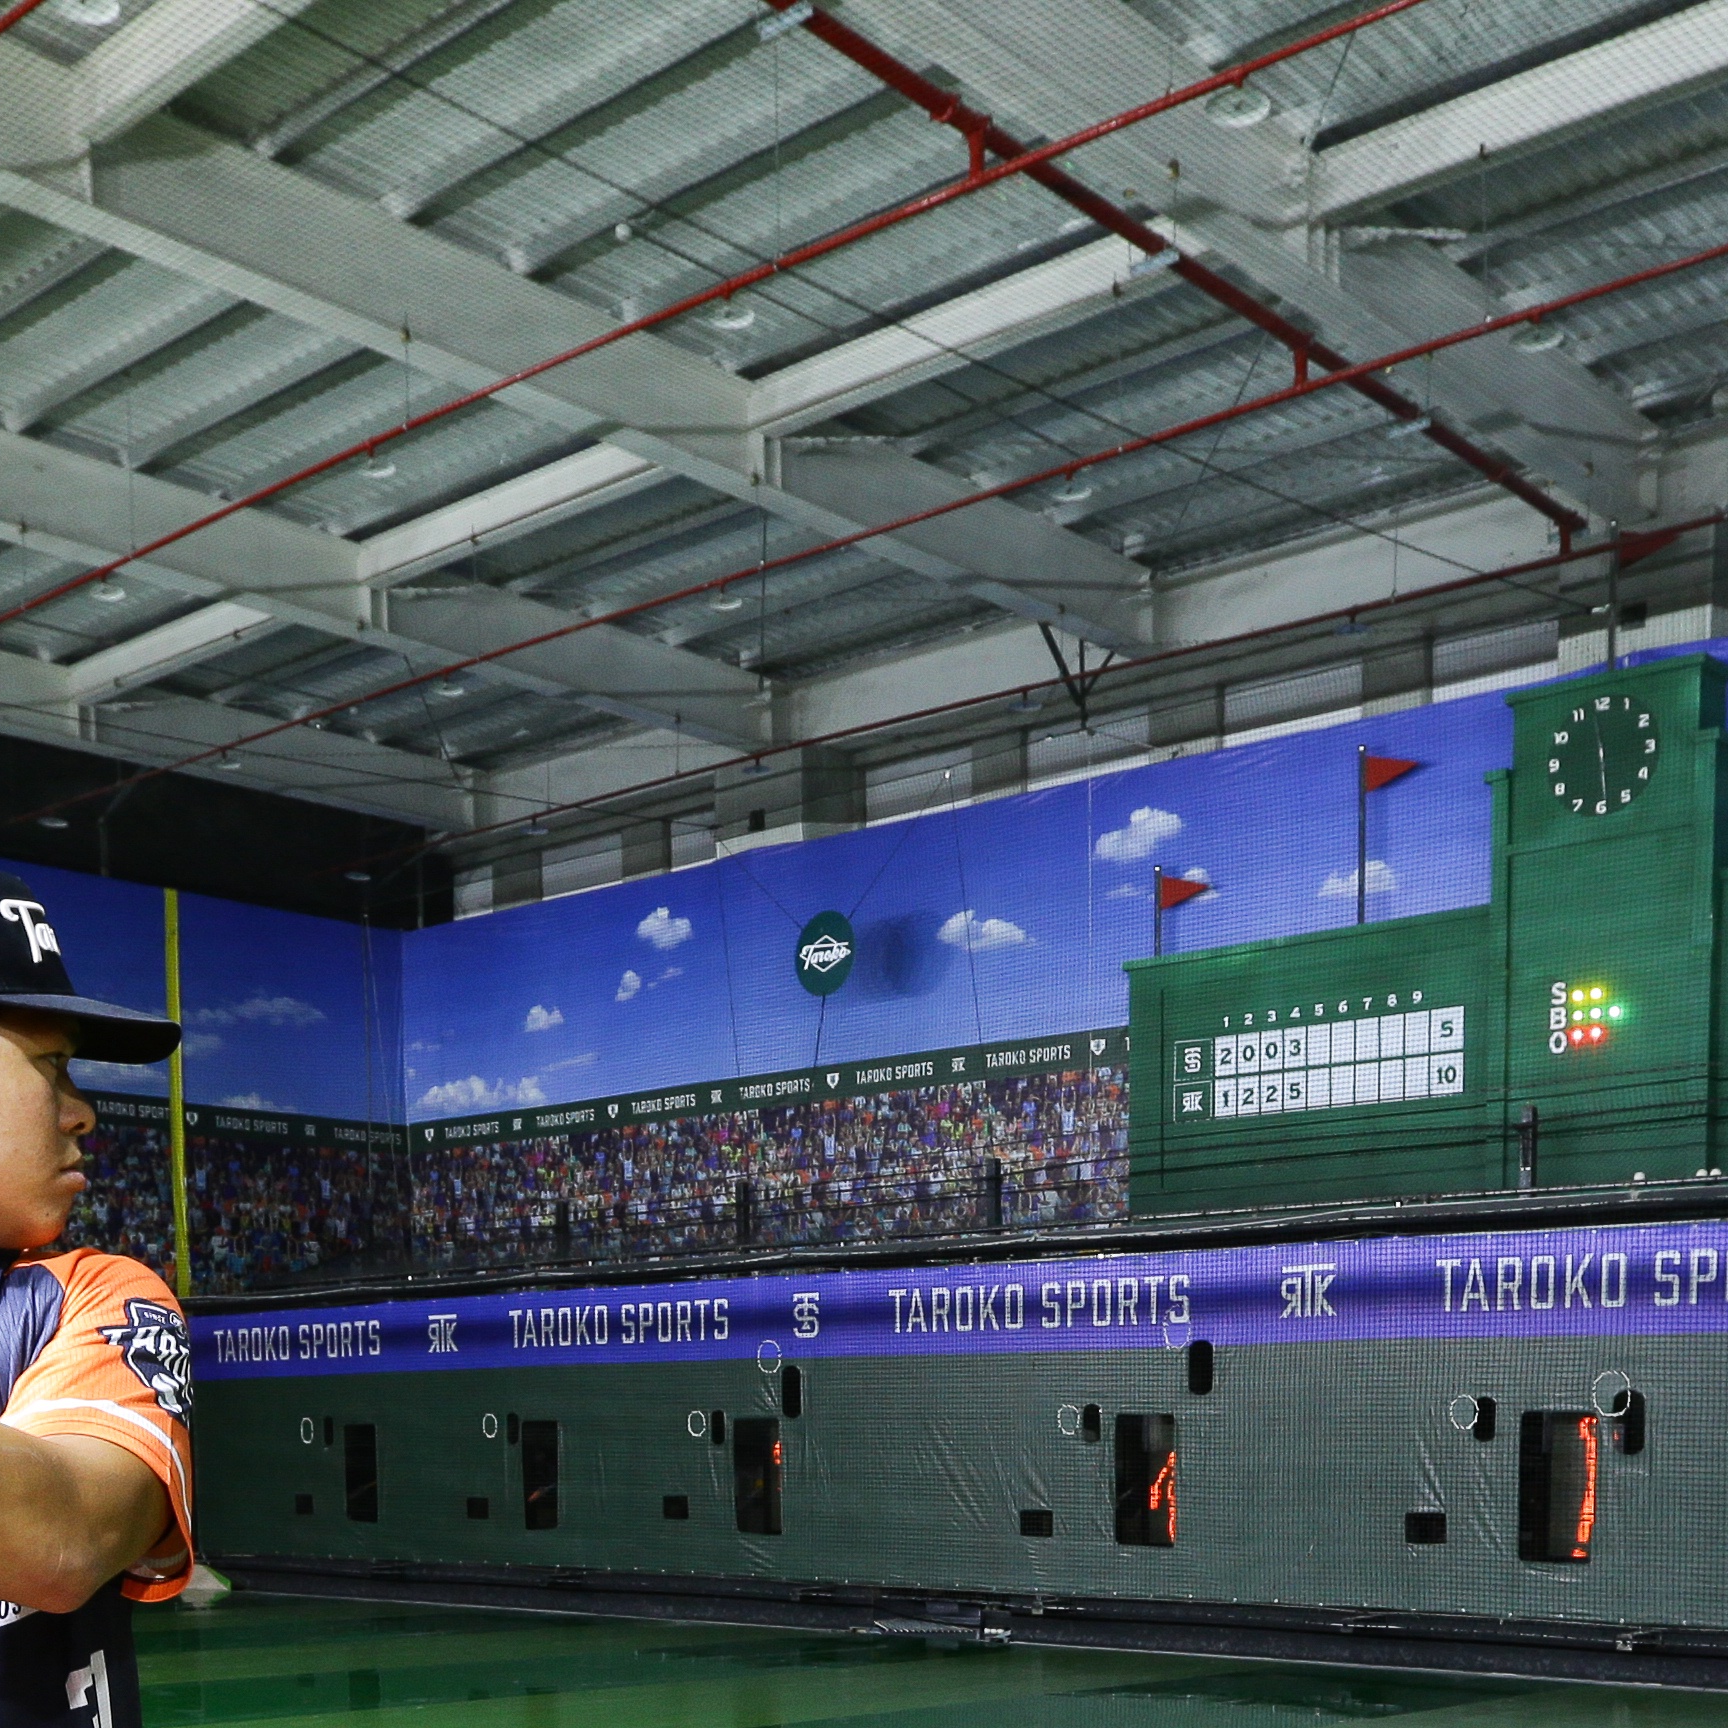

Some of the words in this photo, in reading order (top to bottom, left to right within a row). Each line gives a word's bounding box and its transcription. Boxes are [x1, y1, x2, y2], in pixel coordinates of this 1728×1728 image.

[1594, 696, 1611, 711] 12
[1623, 697, 1630, 711] 1
[1572, 708, 1585, 722] 11
[1638, 713, 1650, 728] 2
[1553, 731, 1569, 745] 10
[1644, 738, 1656, 754] 3
[1548, 758, 1560, 773] 9
[1638, 766, 1649, 780] 4
[1554, 782, 1566, 796] 8
[1620, 789, 1631, 804] 5
[1572, 798, 1584, 812] 7
[1595, 799, 1607, 815] 6
[801, 941, 850, 971] Taroko
[1551, 981, 1567, 1005] S
[1222, 1016, 1230, 1028] 1
[1244, 1013, 1254, 1026] 2
[1267, 1010, 1277, 1023] 3
[1289, 1006, 1301, 1019] 4
[1314, 1003, 1324, 1017] 5
[1338, 1000, 1349, 1014] 6
[1362, 996, 1373, 1010] 7
[1387, 993, 1398, 1007] 8
[1412, 990, 1423, 1004] 9
[1550, 1006, 1568, 1030] B
[1220, 1048, 1232, 1066] 2
[1242, 1044, 1255, 1062] 0
[1265, 1041, 1278, 1059] 0
[1289, 1038, 1302, 1056] 3
[1440, 1020, 1454, 1038] 5
[985, 1050, 1026, 1068] TAROKO
[1029, 1045, 1071, 1064] SPORTS
[856, 1066, 893, 1084] TAROKO
[895, 1061, 934, 1081] SPORTS
[739, 1083, 772, 1099] TAROKO
[775, 1078, 811, 1096] SPORTS
[1222, 1091, 1230, 1108] 1
[1242, 1088, 1255, 1106] 2
[1265, 1085, 1278, 1103] 2
[1289, 1082, 1302, 1100] 5
[1436, 1066, 1457, 1085] 10
[138, 1104, 171, 1120] SPORT
[631, 1097, 662, 1114] TAROKO
[664, 1094, 696, 1111] SPORTS
[1435, 1251, 1627, 1313] TAROKO
[888, 1281, 1024, 1334] TAROKO
[1041, 1273, 1191, 1332] SPORTS
[508, 1305, 608, 1348] TAROKO
[622, 1298, 729, 1344] SPORTS
[213, 1325, 290, 1363] TAROKO
[298, 1319, 381, 1359] SPORTS
